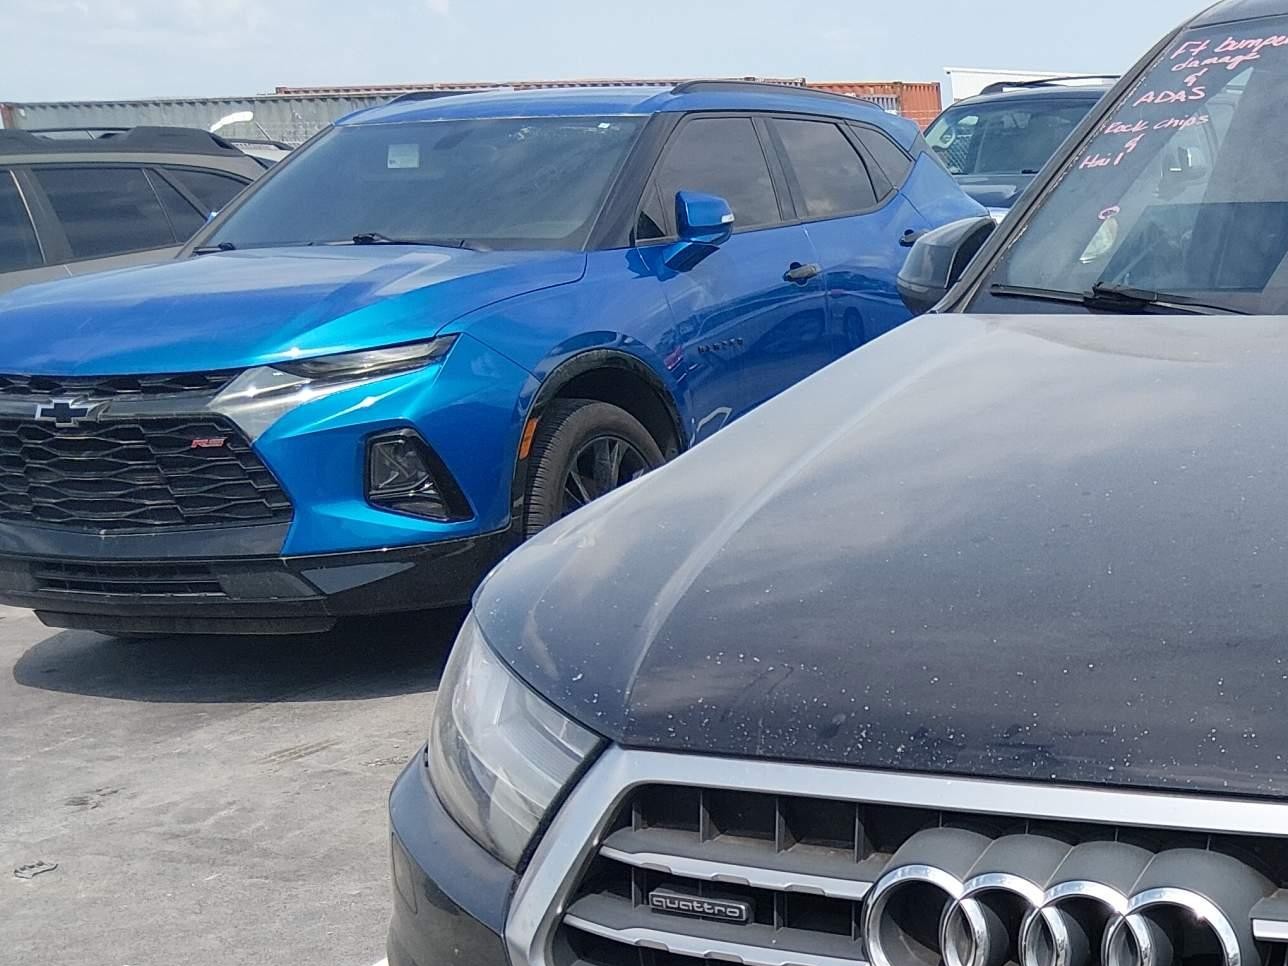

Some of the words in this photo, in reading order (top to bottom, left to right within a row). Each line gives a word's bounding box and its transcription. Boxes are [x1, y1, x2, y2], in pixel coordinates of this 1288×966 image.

[1171, 52, 1261, 72] damage
[1132, 86, 1206, 107] ADAS
[190, 438, 226, 449] RS
[652, 896, 741, 918] quattro
